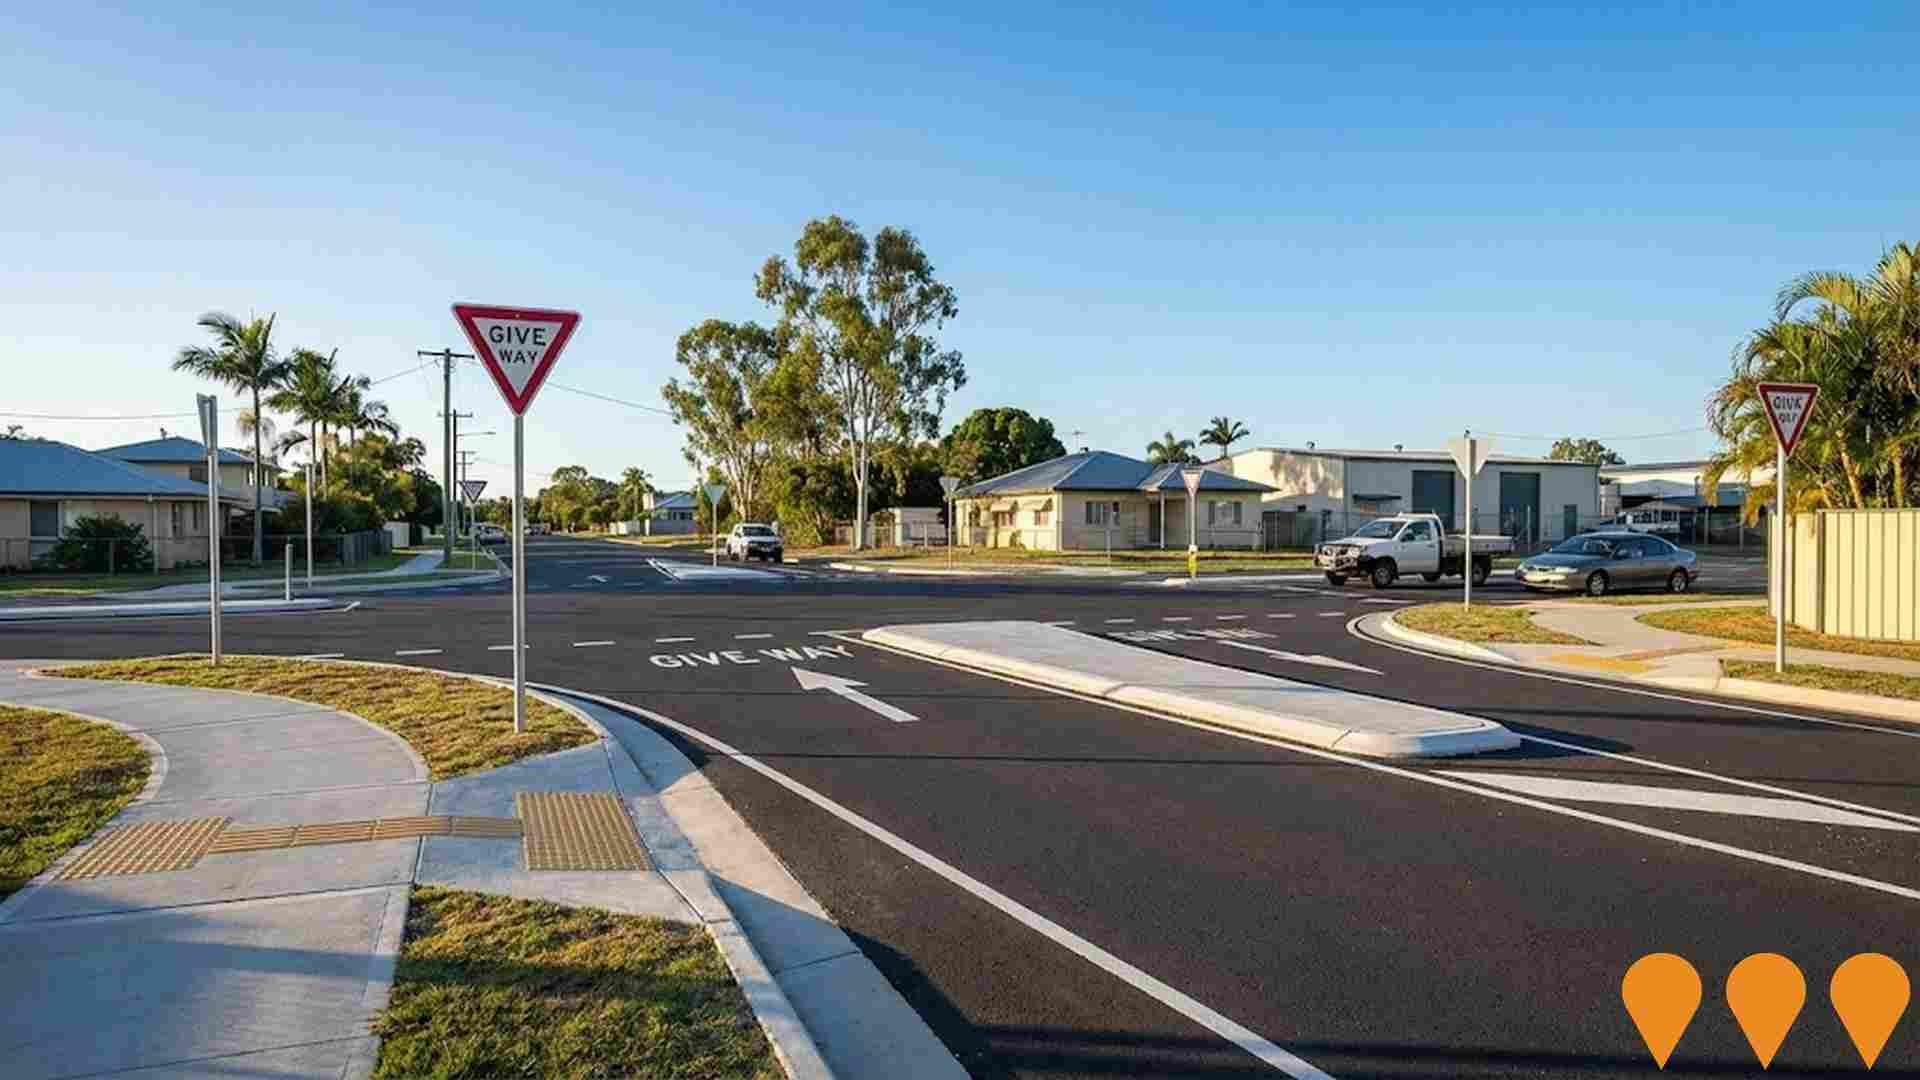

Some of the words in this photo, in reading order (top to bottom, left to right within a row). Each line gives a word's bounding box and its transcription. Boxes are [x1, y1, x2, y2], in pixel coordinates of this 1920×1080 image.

[489, 325, 546, 346] GIVE
[499, 349, 537, 363] WAY
[650, 651, 760, 668] GIVE
[758, 646, 854, 661] WAY
